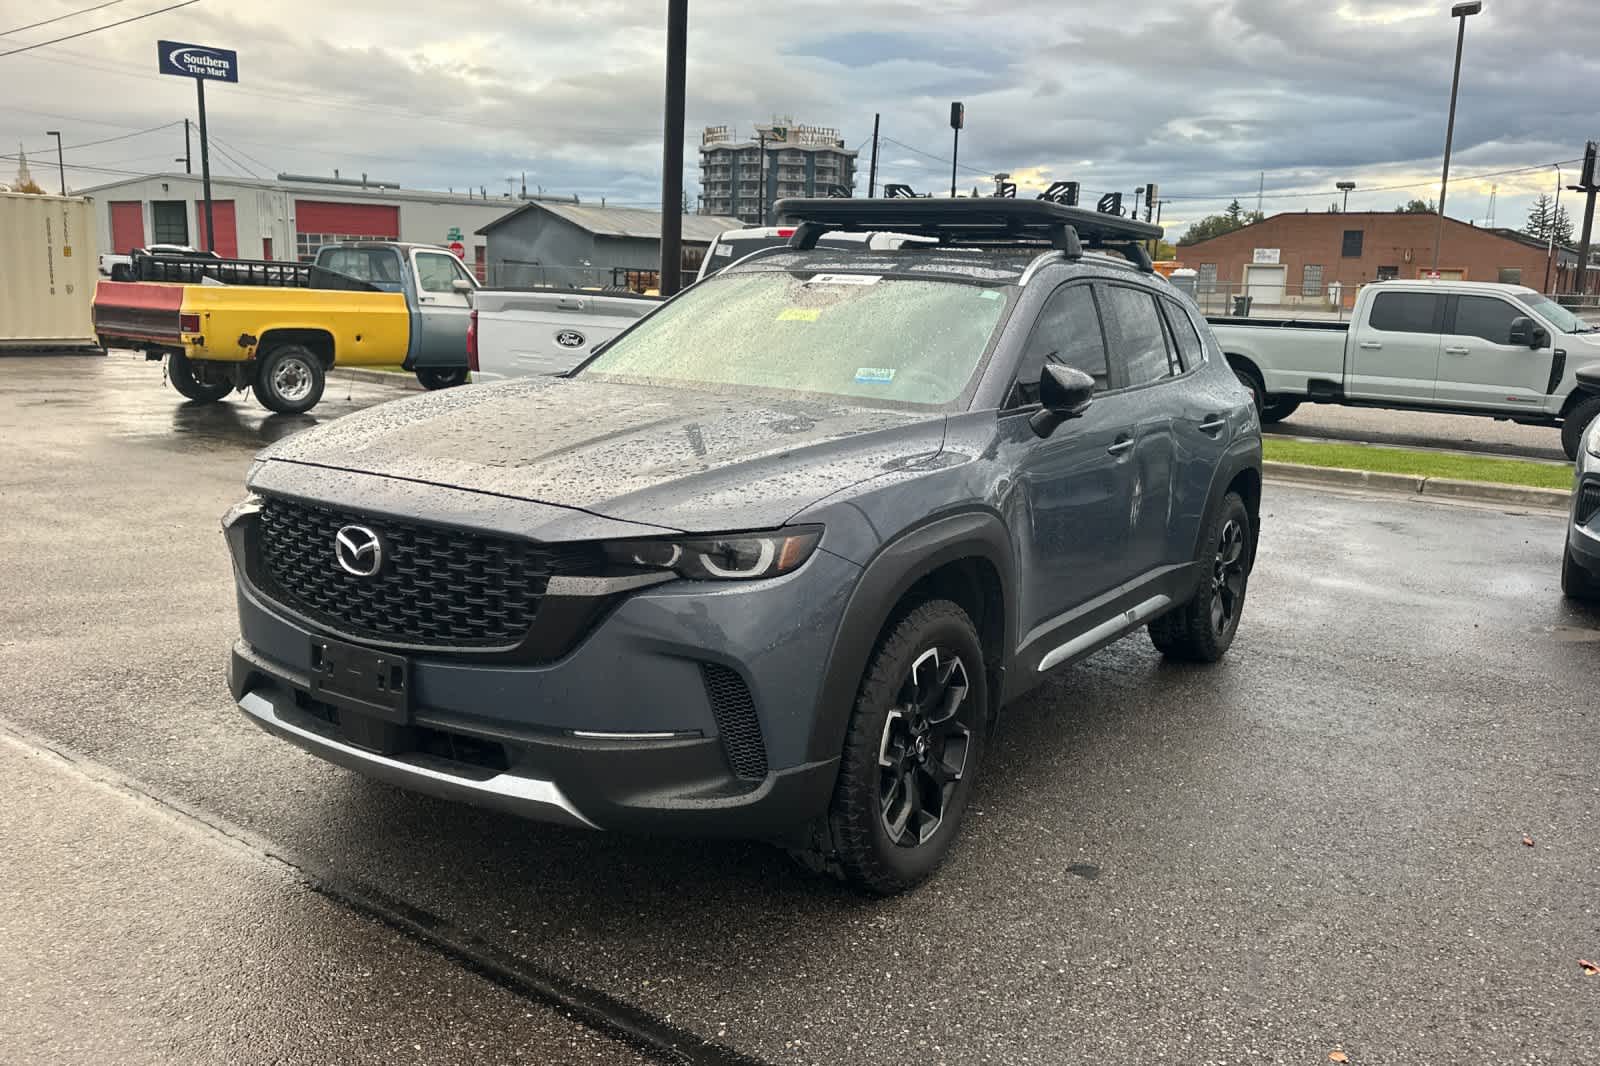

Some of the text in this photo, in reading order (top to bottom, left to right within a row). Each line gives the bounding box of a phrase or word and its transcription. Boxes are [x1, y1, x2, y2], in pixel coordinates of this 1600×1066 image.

[183, 53, 230, 69] Southern
[188, 64, 226, 77] Tire Mart
[560, 333, 580, 345] Ford
